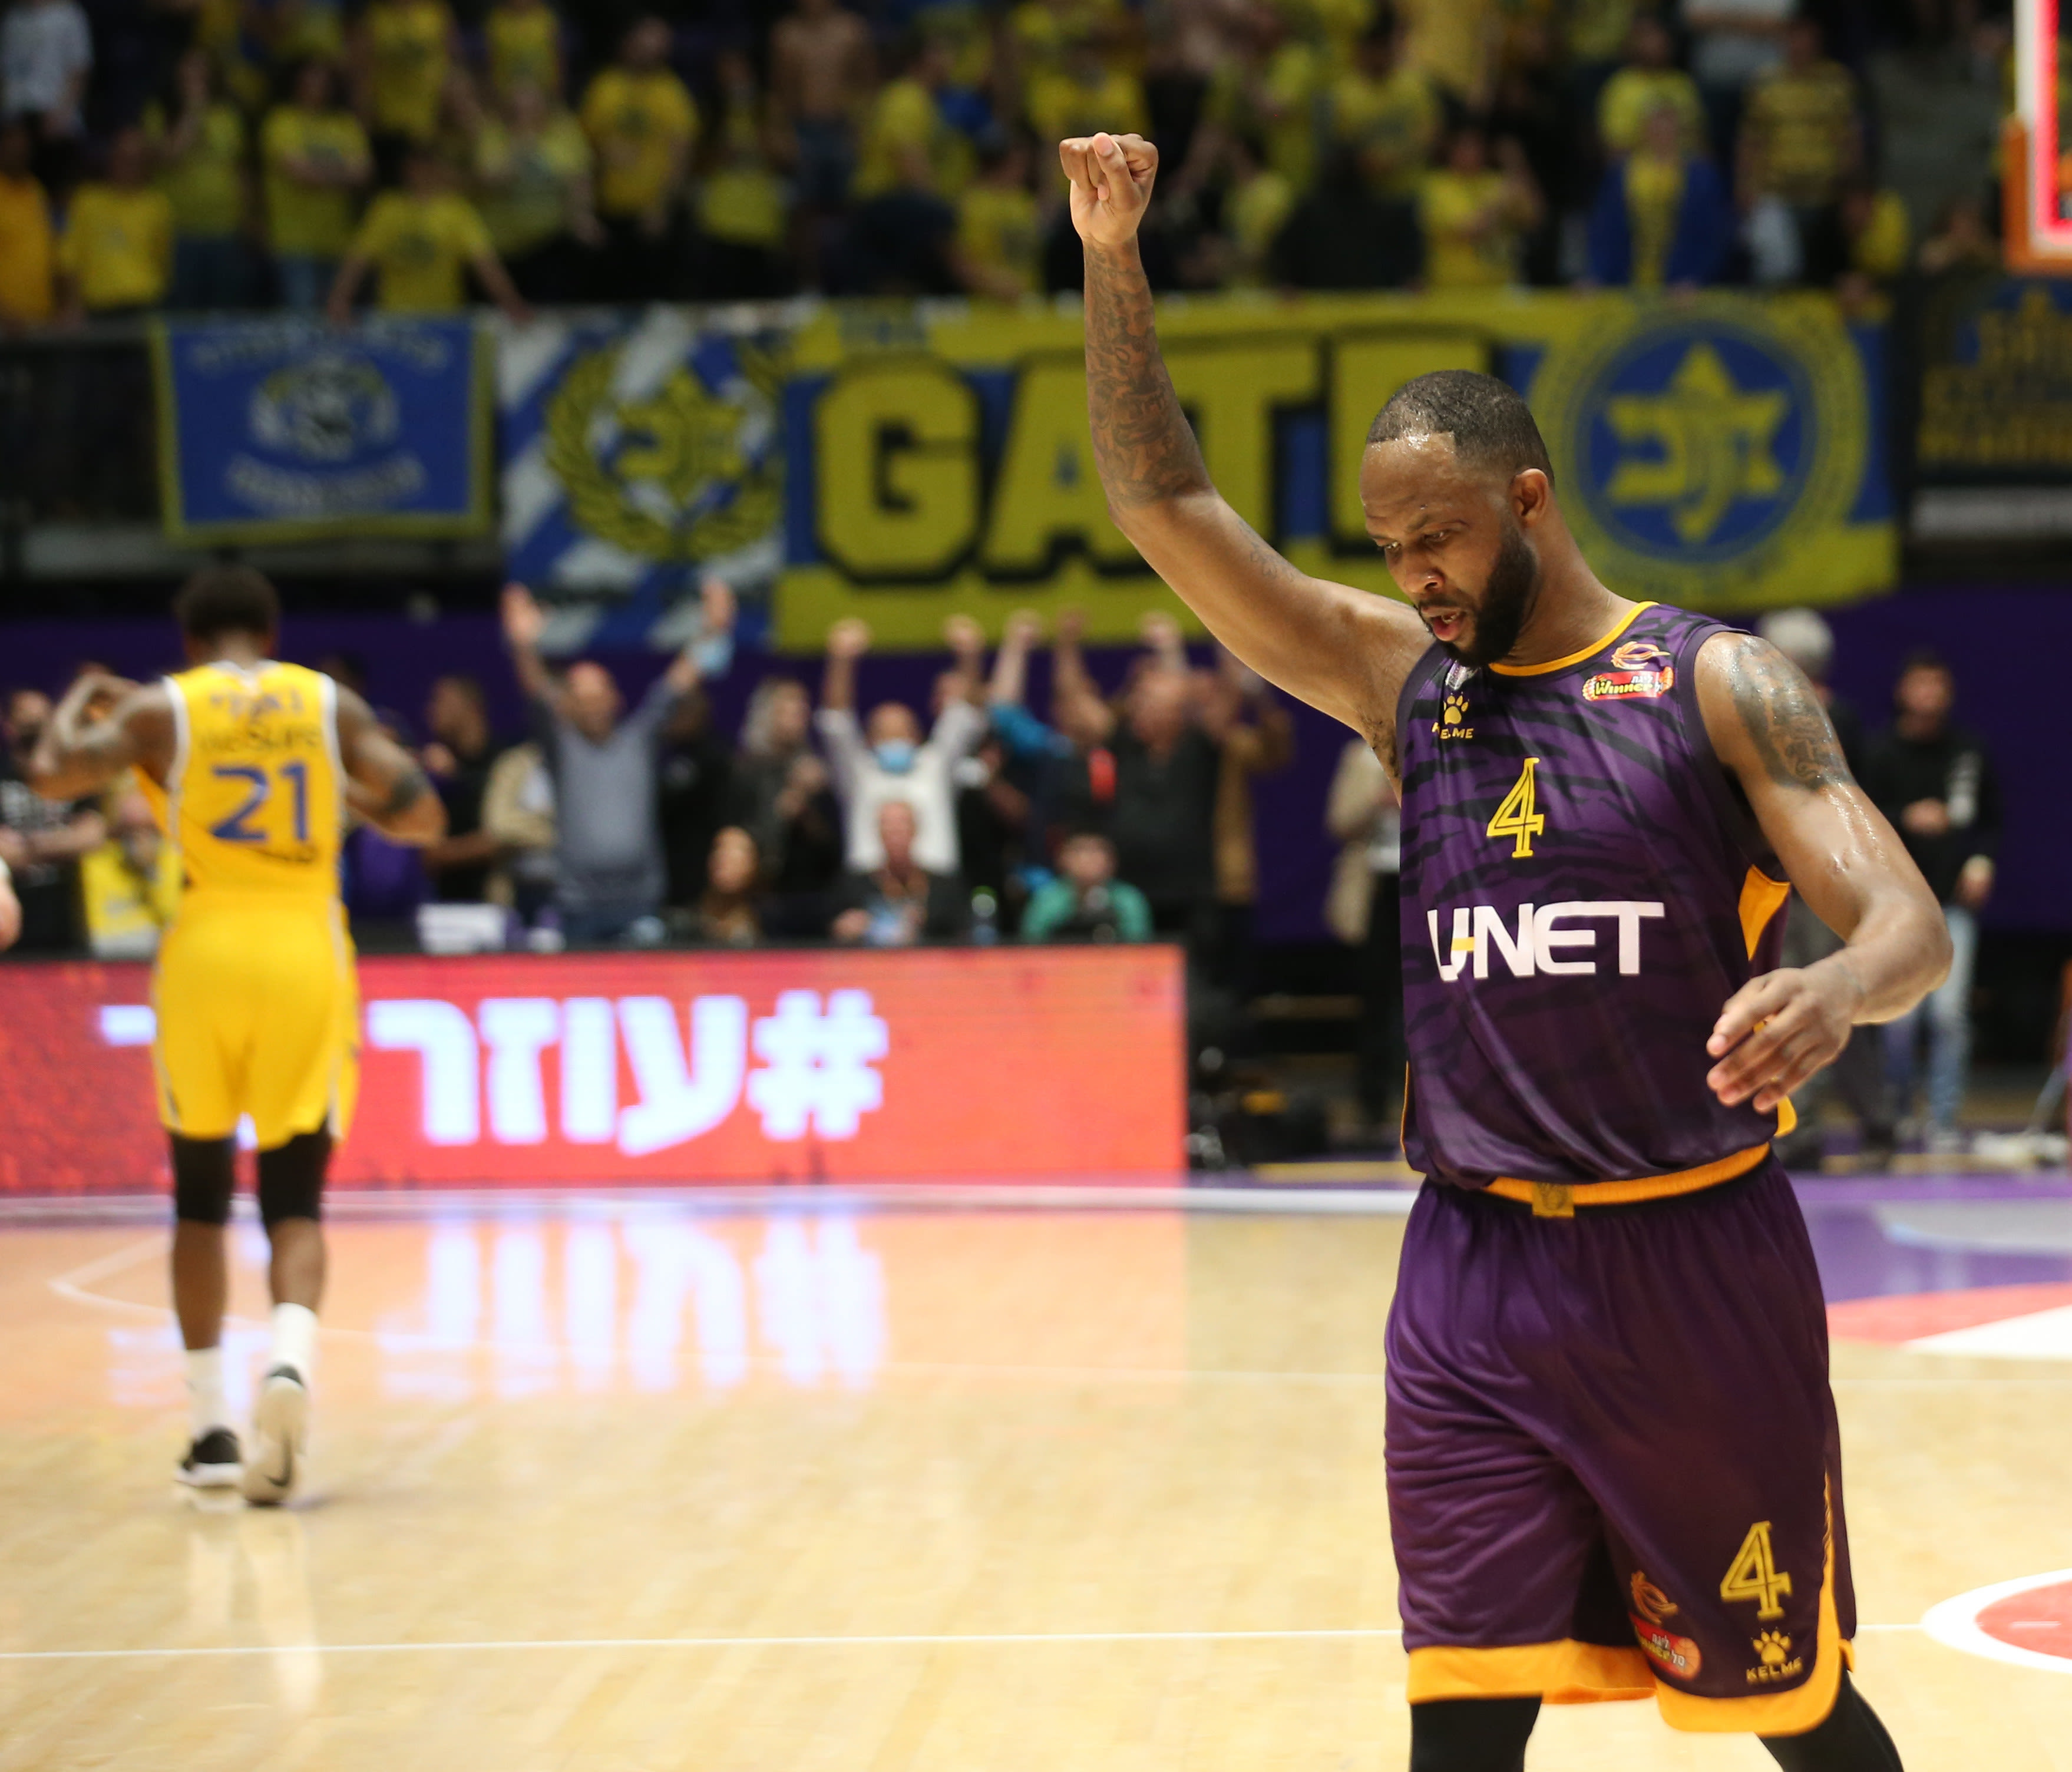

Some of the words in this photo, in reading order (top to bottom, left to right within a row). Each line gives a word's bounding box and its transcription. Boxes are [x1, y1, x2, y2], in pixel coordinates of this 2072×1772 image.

[1595, 680, 1654, 695] Winner
[213, 762, 309, 842] 21
[1486, 757, 1545, 858] 4
[1720, 1520, 1793, 1620] 4
[1746, 1656, 1803, 1685] KELME
